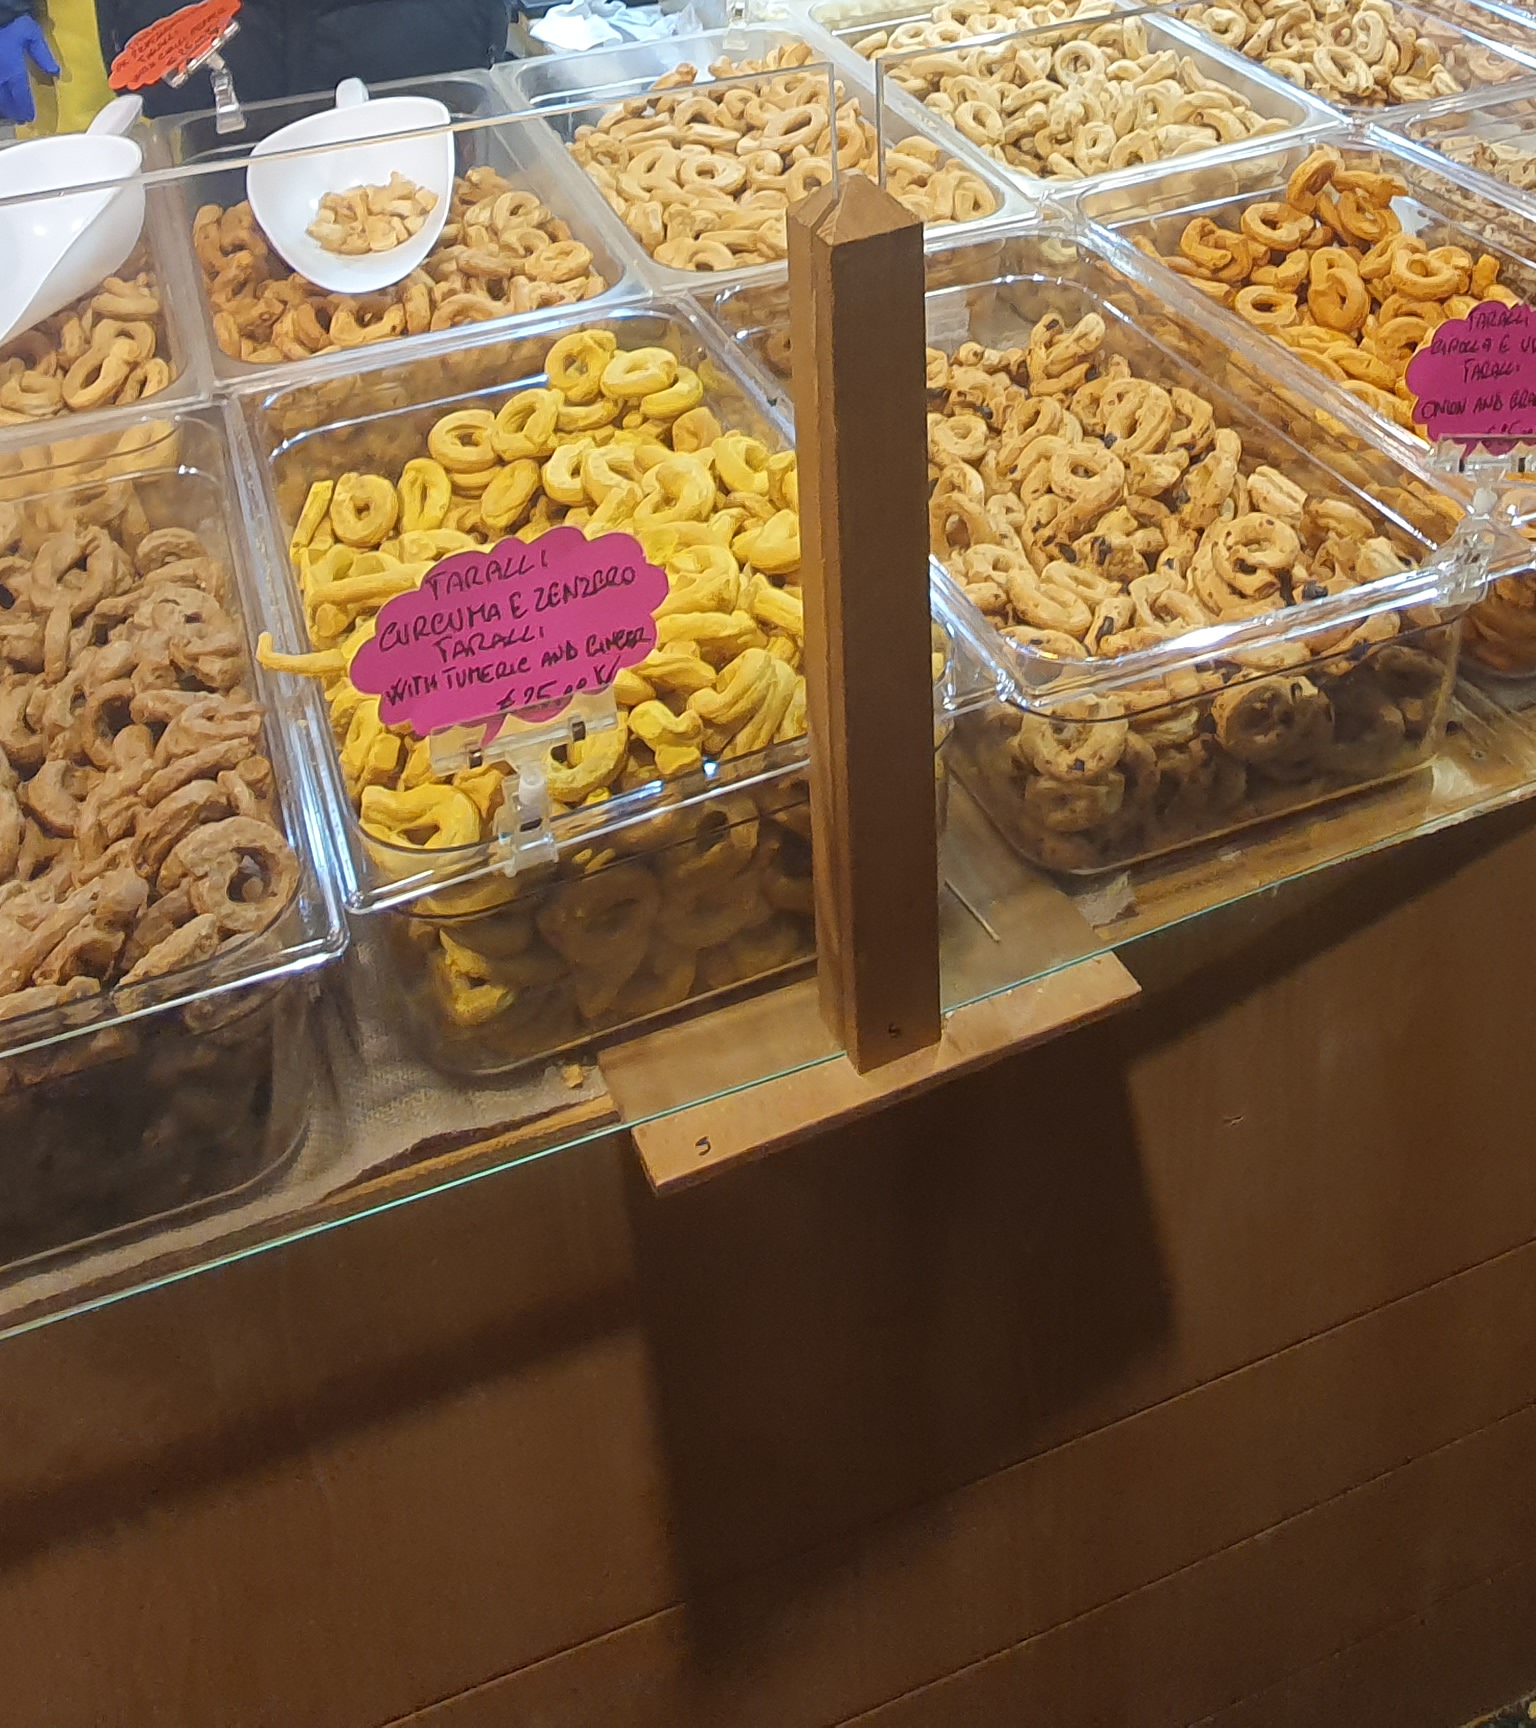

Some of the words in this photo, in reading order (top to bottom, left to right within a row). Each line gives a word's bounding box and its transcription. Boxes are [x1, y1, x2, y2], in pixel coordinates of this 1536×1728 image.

[1473, 393, 1504, 414] AND
[425, 549, 549, 601] TARALLI
[379, 601, 502, 653] CURCUMA
[511, 591, 528, 620] E
[431, 625, 545, 664] TARALLI
[384, 671, 439, 706] WITH
[541, 641, 579, 668] AND
